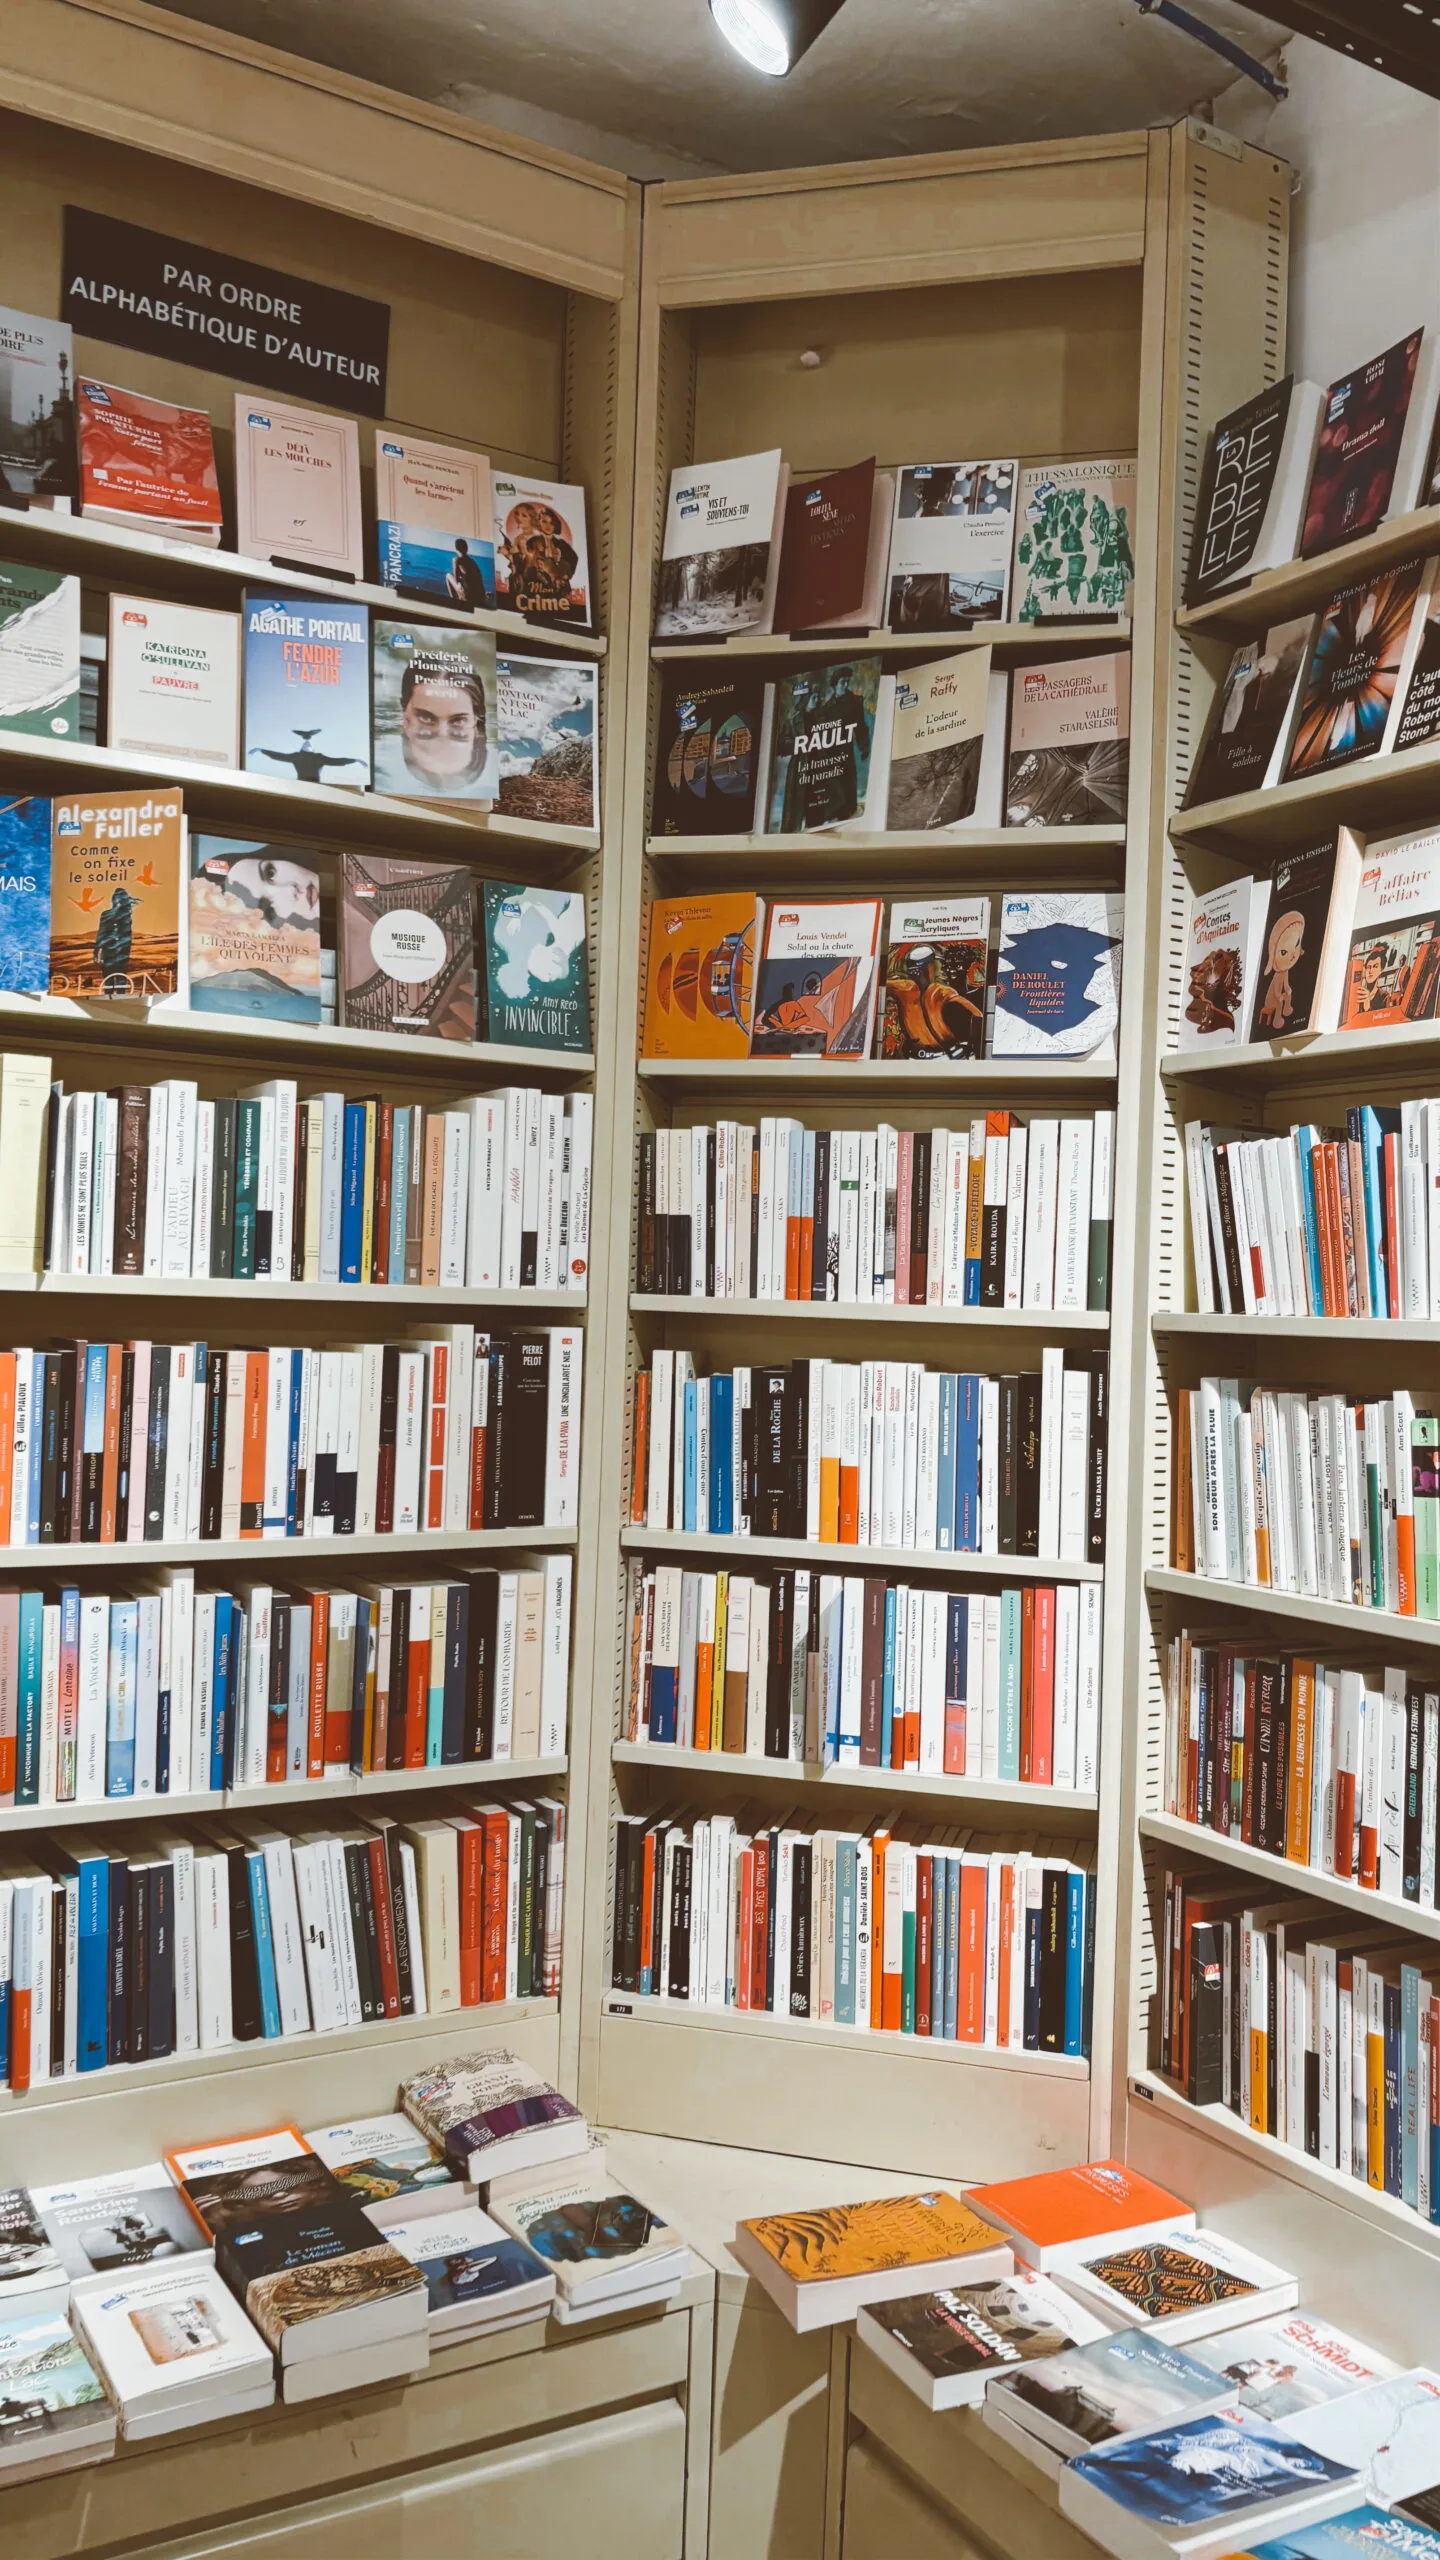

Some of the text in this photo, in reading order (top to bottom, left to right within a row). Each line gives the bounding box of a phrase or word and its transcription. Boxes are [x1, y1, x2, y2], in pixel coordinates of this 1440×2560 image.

[163, 263, 301, 325] PAR ORDRE
[69, 276, 257, 350] ALPHABÉTIQUE
[93, 408, 133, 425] SOPHIE
[95, 414, 161, 439] POINTURIER
[1341, 418, 1386, 452] Drama doll
[286, 440, 310, 455] DÉJÀ
[264, 447, 332, 469] LES MOUCHES
[403, 474, 428, 489] Quand
[1025, 464, 1135, 483] THESSALONIQUE
[414, 487, 427, 497] les
[708, 497, 728, 509] VIS ET
[707, 504, 749, 521] SOUVIENS-TOI
[389, 524, 401, 582] PANCRAZI
[1371, 577, 1381, 586] DE
[1383, 559, 1420, 580] ROSNAY
[515, 594, 570, 611] Crime
[249, 612, 365, 644] AGATHE PORTAIL
[145, 641, 207, 659] KATRIONA
[282, 641, 343, 667] FENDRE
[1348, 650, 1366, 664] Les
[141, 653, 210, 672] O'SULLIVAN
[408, 659, 473, 676] Ploussard
[1332, 656, 1378, 683] Fleurs de
[286, 661, 341, 686] L'AZUR
[414, 674, 469, 689] Premier
[935, 673, 955, 684] Serge
[152, 676, 200, 691] PAUVRE
[930, 683, 958, 698] Raffy
[1042, 676, 1092, 691] PASSAGERS
[1331, 672, 1373, 694] l'ombre
[1410, 683, 1435, 701] côté
[1024, 683, 1108, 703] DE LA CATHÉDRALE
[926, 709, 959, 724] L'odeur
[1085, 706, 1119, 720] VALÈRE
[1402, 710, 1440, 729] Robert
[811, 719, 842, 732] ANTOINE
[915, 718, 967, 739] de la sardine
[1059, 718, 1119, 733] STARASELSKI
[1399, 725, 1430, 743] Stone
[794, 723, 858, 755] RAULT
[798, 751, 849, 773] La traversée
[799, 766, 844, 785] du paradis
[58, 800, 178, 827] Alexandra
[96, 821, 163, 839] Fuller
[71, 844, 119, 856] Comme
[1277, 842, 1333, 872] JOHANNA SINISALO
[1375, 847, 1398, 860] DAVID
[1401, 845, 1410, 854] LE
[84, 856, 136, 870] on fixe
[68, 870, 128, 883] le soleil
[1379, 889, 1421, 907] Bélias
[925, 915, 979, 924] Jeunes Nègres
[1206, 912, 1231, 929] Contes
[796, 932, 847, 941] Louis Vendel
[921, 925, 960, 933] acryliques
[391, 933, 426, 944] MUSIQUE
[396, 941, 421, 951] RUSSE
[788, 943, 808, 951] Solal
[832, 942, 854, 950] chute
[219, 950, 292, 964] QUI VOLENT
[234, 940, 258, 952] DES
[260, 942, 310, 956] FEMMES
[1012, 973, 1049, 981] DANIEL
[1012, 981, 1065, 989] DE ROULET
[1020, 989, 1065, 998] Frontières
[542, 996, 578, 1011] AMY REED
[1029, 999, 1065, 1008] liquides
[505, 1005, 571, 1037] INVINCIBLE
[176, 1129, 185, 1166] Manuela
[76, 1151, 88, 1246] LES MORTS NE SONT PLUS SEULS
[990, 1209, 999, 1266] KAIRA ROUDA
[522, 1345, 543, 1354] PIERRE
[523, 1356, 542, 1365] PELOT
[18, 1383, 27, 1433] Gilles PIALOUX
[1396, 1411, 1405, 1451] Ann Scott
[773, 1436, 781, 1448] LA
[1210, 1436, 1216, 1447] LA
[773, 1450, 781, 1463] DE
[1208, 1449, 1217, 1477] APRÈS
[1211, 1512, 1219, 1531] SON
[63, 1663, 74, 1698] Lorraine
[500, 1620, 512, 1725] RETOUR DE LOMBARDE
[314, 1662, 324, 1738] ROULETTE RUSSE
[64, 1702, 73, 1736] MOTEL
[1295, 1674, 1307, 1778] LA JEUNESSE DU MONDE
[1408, 1695, 1420, 1817] GREENLAND HEINRICH STEINFEST
[394, 1884, 410, 1974] LA ENCOMIENDA
[1406, 2065, 1417, 2136] REAL LIFE
[53, 2196, 139, 2218] Sandrine
[59, 2205, 137, 2227] Roudeix
[933, 2290, 1022, 2361] PAZ SOLDÁN
[1283, 2325, 1376, 2380] SCHMIDT
